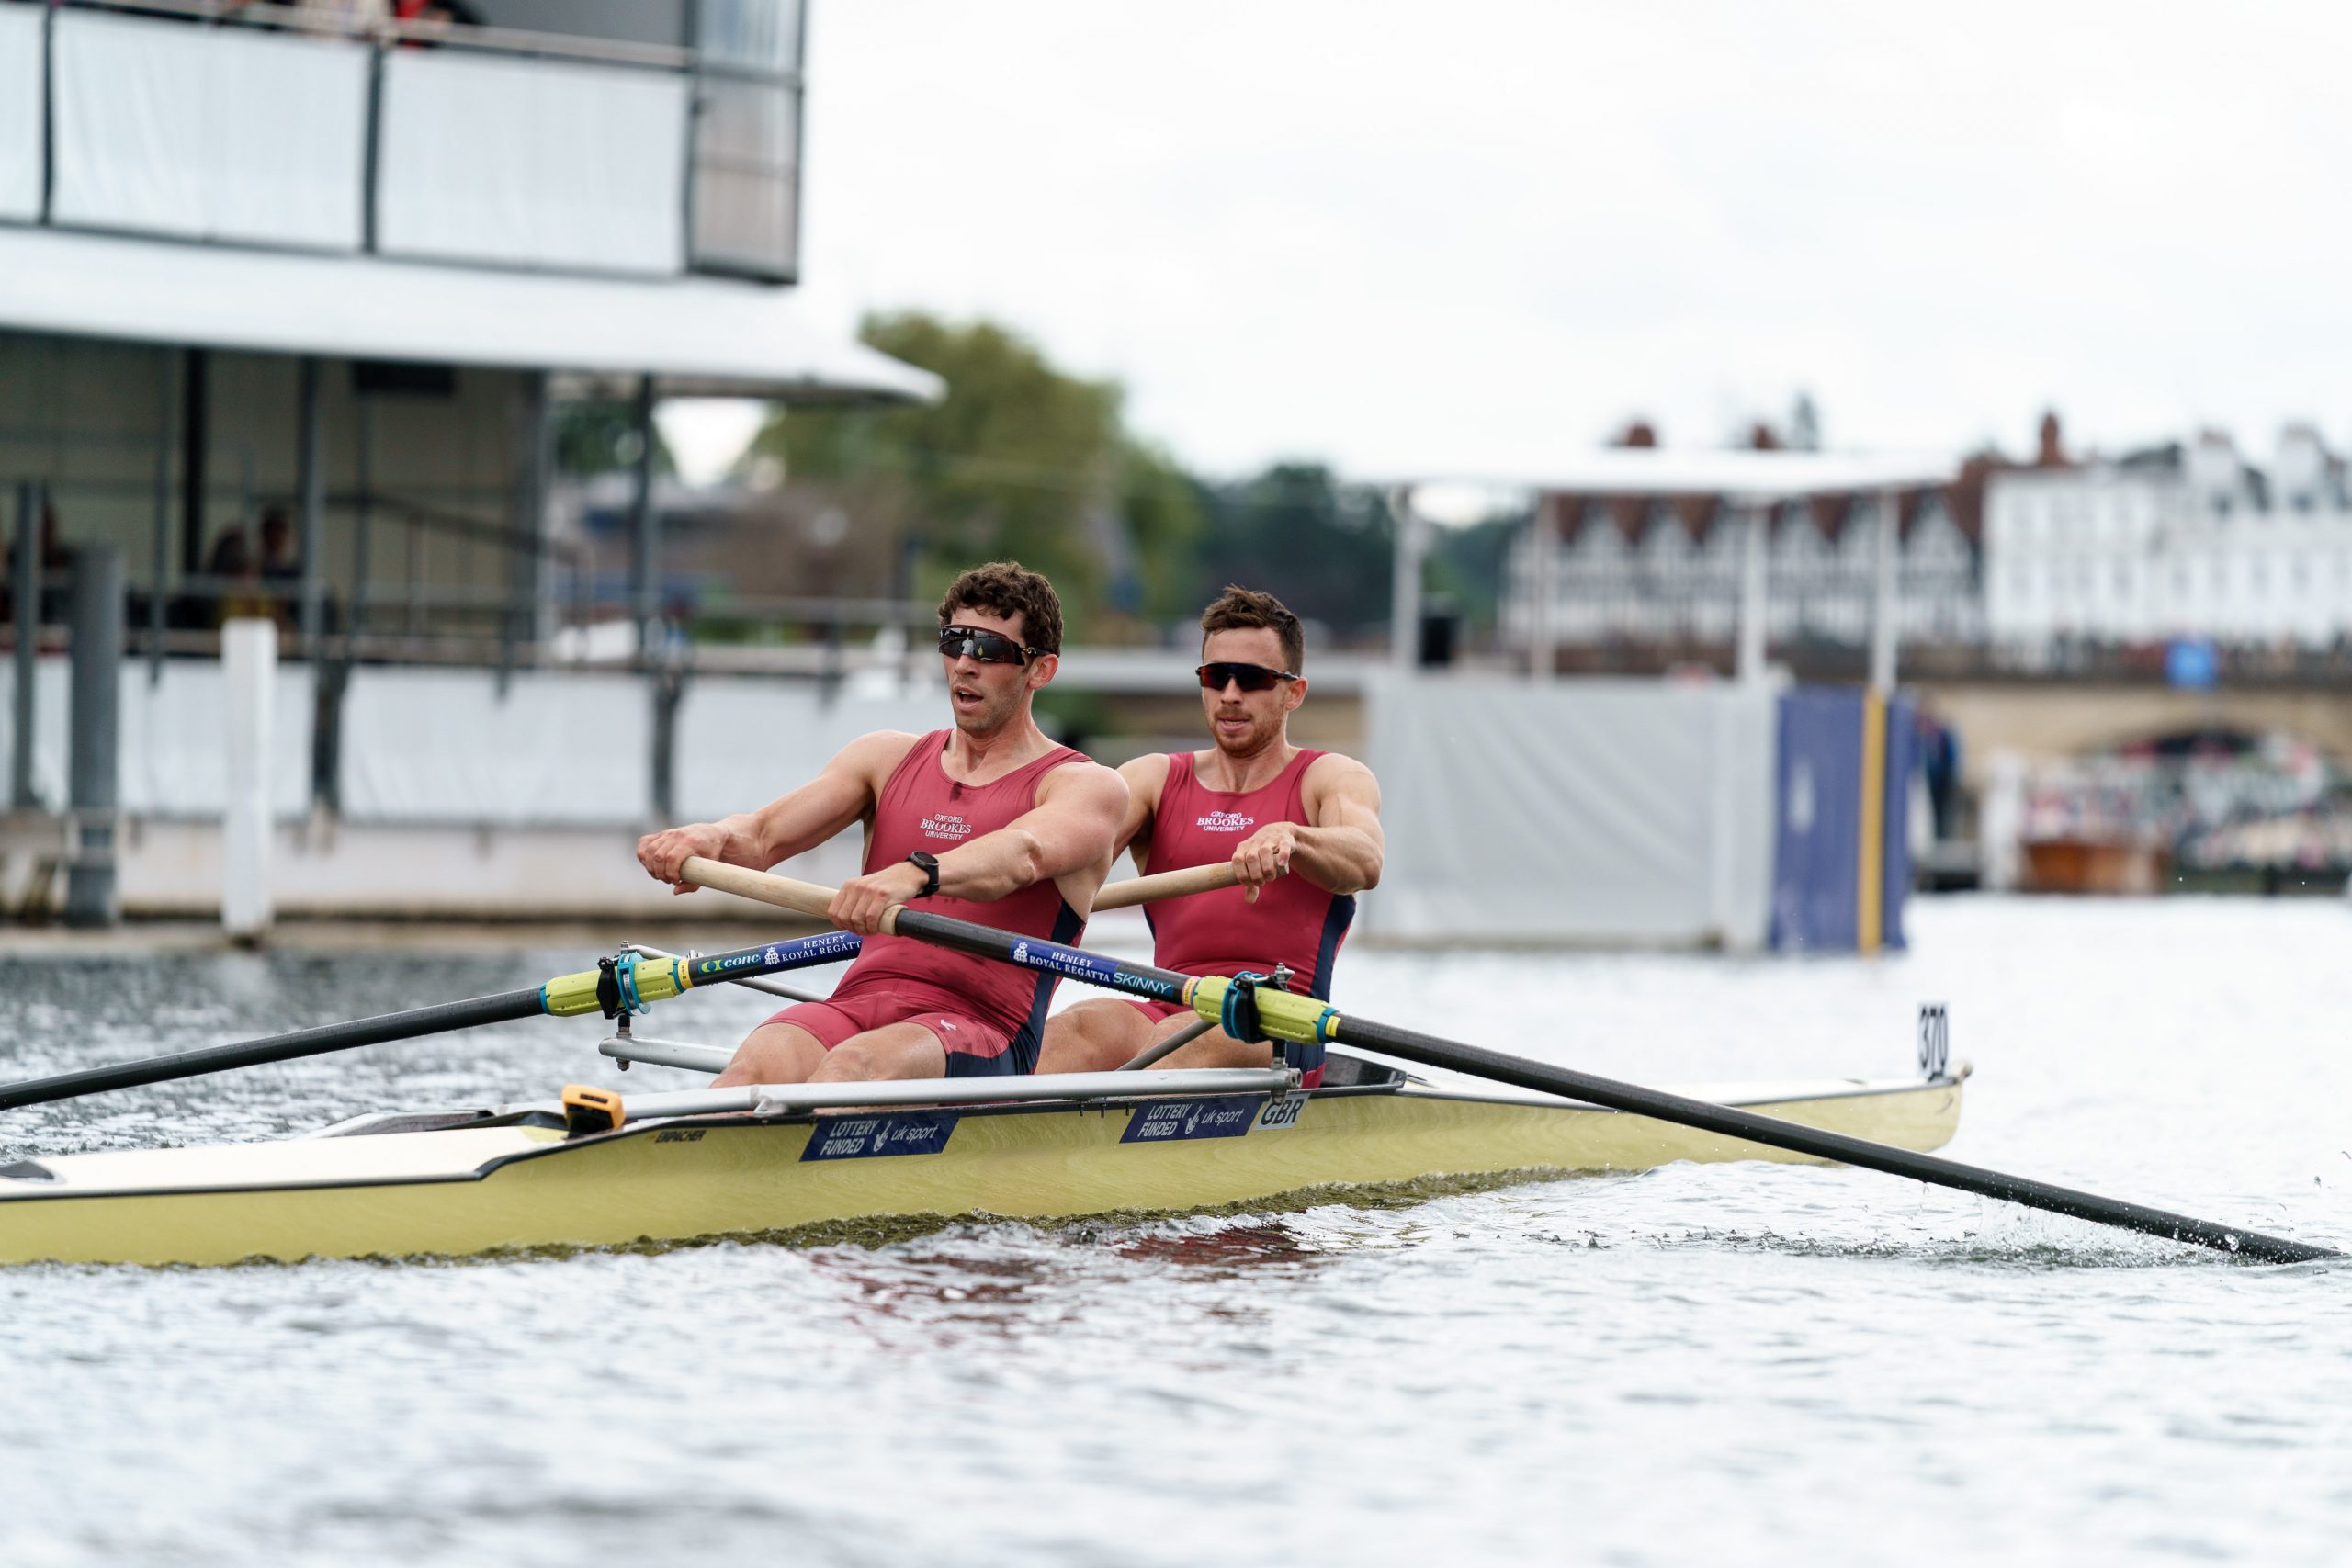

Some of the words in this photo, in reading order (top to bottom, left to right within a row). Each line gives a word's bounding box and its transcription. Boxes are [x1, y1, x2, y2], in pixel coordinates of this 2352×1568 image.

[934, 813, 963, 824] OXFORD
[1196, 817, 1254, 827] BROOKES
[1210, 810, 1242, 819] OXFORD
[920, 818, 971, 834] BROOKES
[925, 829, 964, 840] UNIVERSITY
[803, 935, 846, 949] HENLEY
[724, 954, 761, 967] conc
[782, 949, 818, 963] ROYAL
[820, 941, 862, 955] REGATT
[1051, 951, 1093, 968] HENLEY
[1029, 955, 1062, 971] ROYAL
[1064, 965, 1110, 983] REGATTA
[1113, 972, 1172, 994] SKINNY
[1919, 1005, 1949, 1071] 370
[1147, 1103, 1192, 1121] LOTTERY
[1201, 1110, 1216, 1124] uk
[1215, 1108, 1245, 1127] sport
[1261, 1098, 1306, 1126] GBR
[830, 1120, 880, 1137] LOTTERY
[891, 1125, 907, 1142] uk
[907, 1124, 939, 1144] sport
[1137, 1121, 1178, 1138] FUNDED
[820, 1138, 865, 1156] FUNDED
